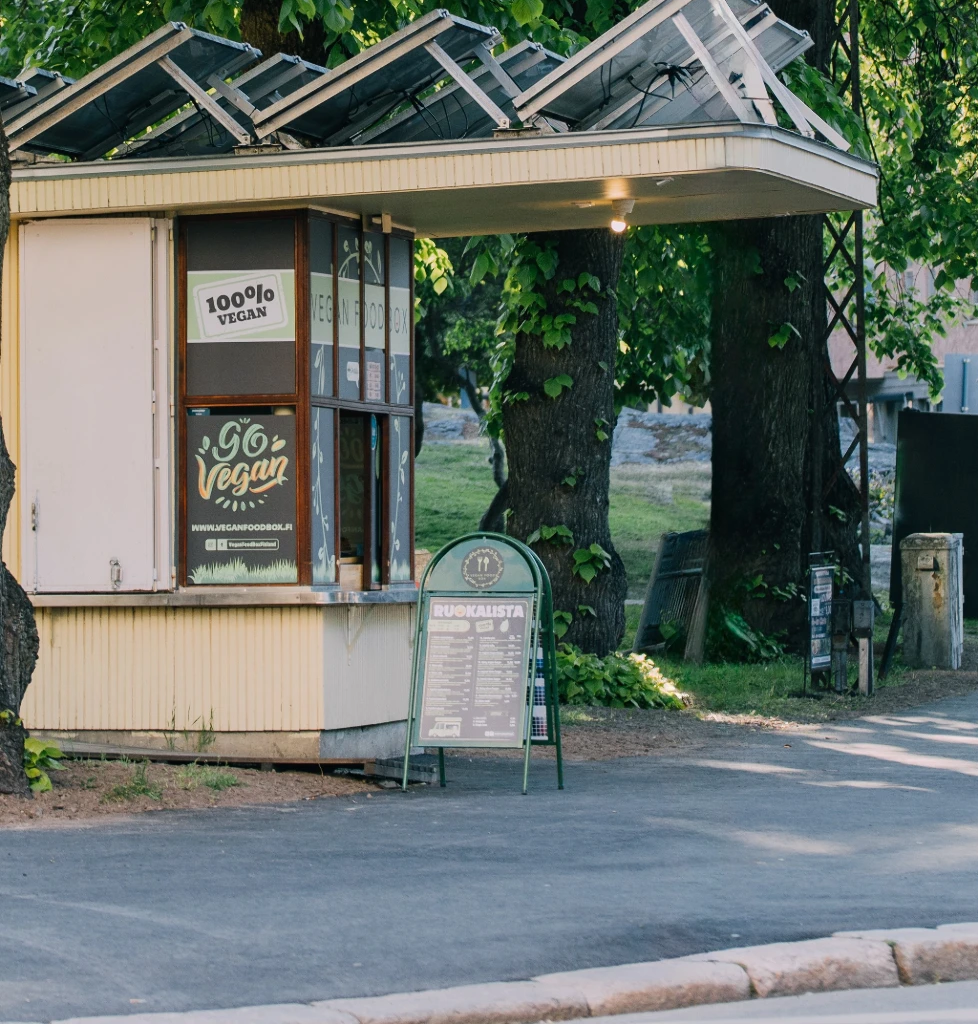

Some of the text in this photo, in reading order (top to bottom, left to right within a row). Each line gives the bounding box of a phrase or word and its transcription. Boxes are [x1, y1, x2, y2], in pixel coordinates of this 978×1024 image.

[206, 284, 275, 313] 100%
[217, 306, 267, 325] VEGAN
[195, 455, 289, 500] Vegan
[191, 523, 293, 532] WWW.VEGANFOODBOX.FI
